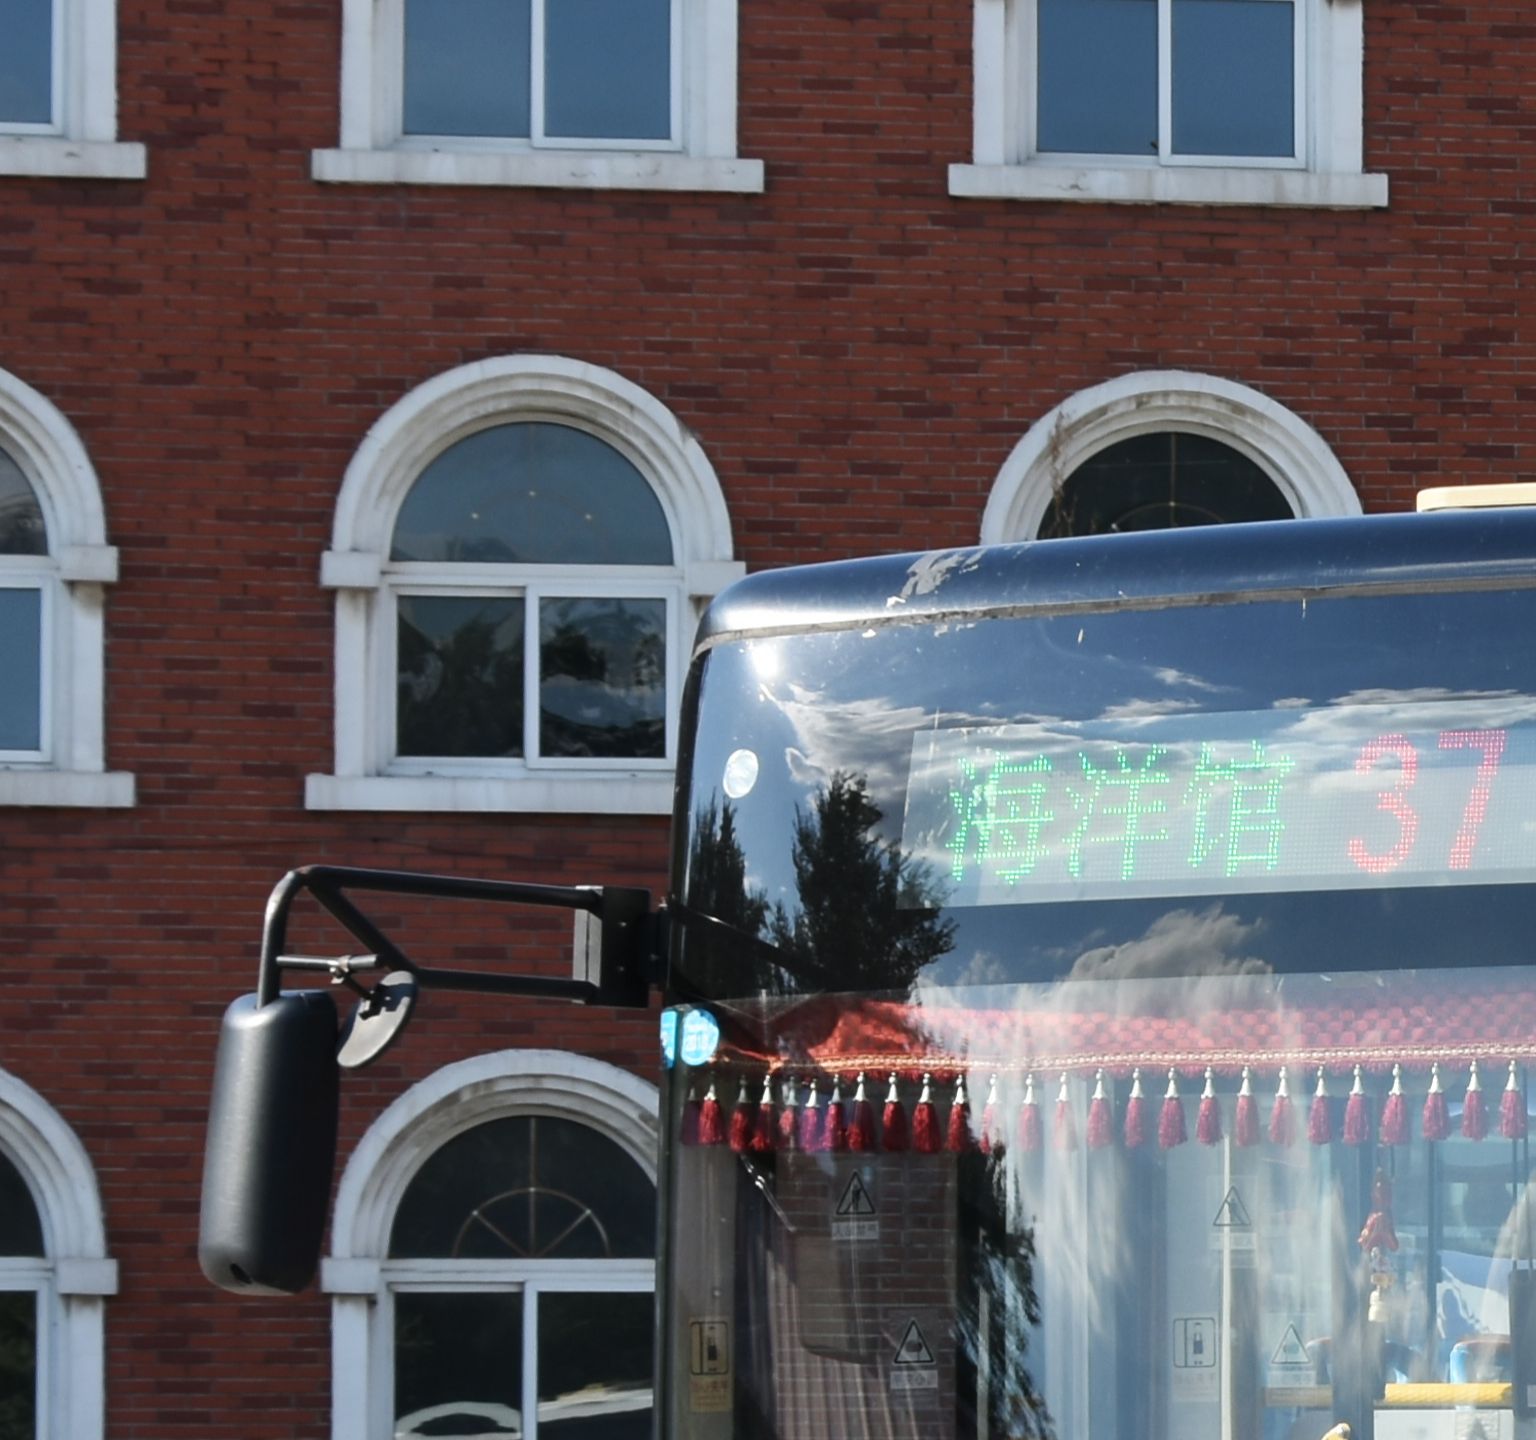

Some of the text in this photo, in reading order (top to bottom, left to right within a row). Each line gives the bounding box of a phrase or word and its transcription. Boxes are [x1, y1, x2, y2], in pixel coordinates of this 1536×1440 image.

[946, 738, 1295, 887] 海洋馆
[1347, 727, 1508, 875] 37
